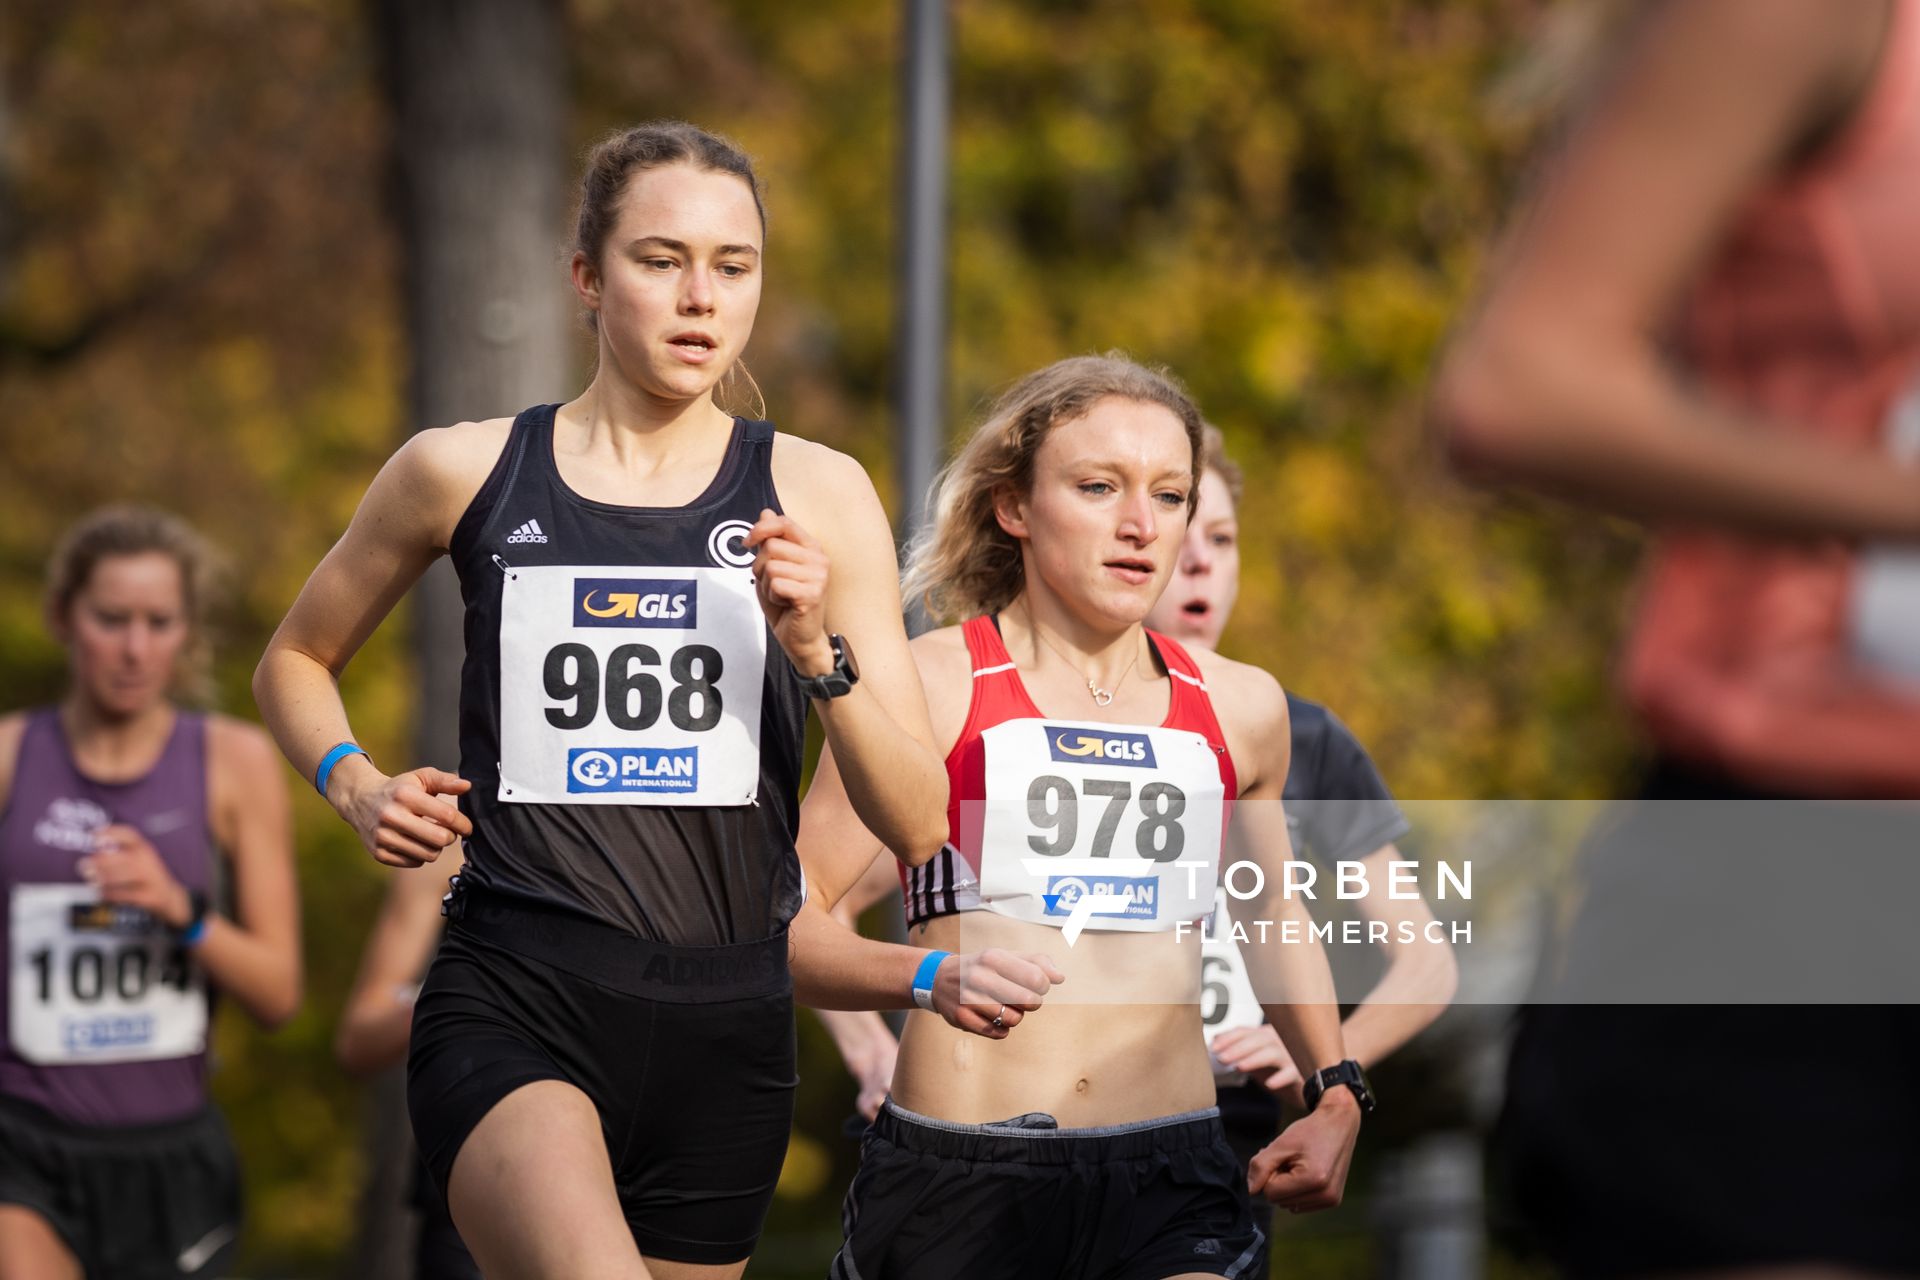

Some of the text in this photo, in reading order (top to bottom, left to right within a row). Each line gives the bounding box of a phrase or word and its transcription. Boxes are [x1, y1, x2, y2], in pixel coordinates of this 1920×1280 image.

[507, 533, 548, 544] adidas
[638, 593, 688, 619] GLS
[543, 643, 724, 732] 968
[1103, 740, 1146, 761] GLS
[622, 755, 694, 776] PLAN
[622, 779, 692, 787] INTERNATIONAL
[1026, 775, 1186, 863] 978
